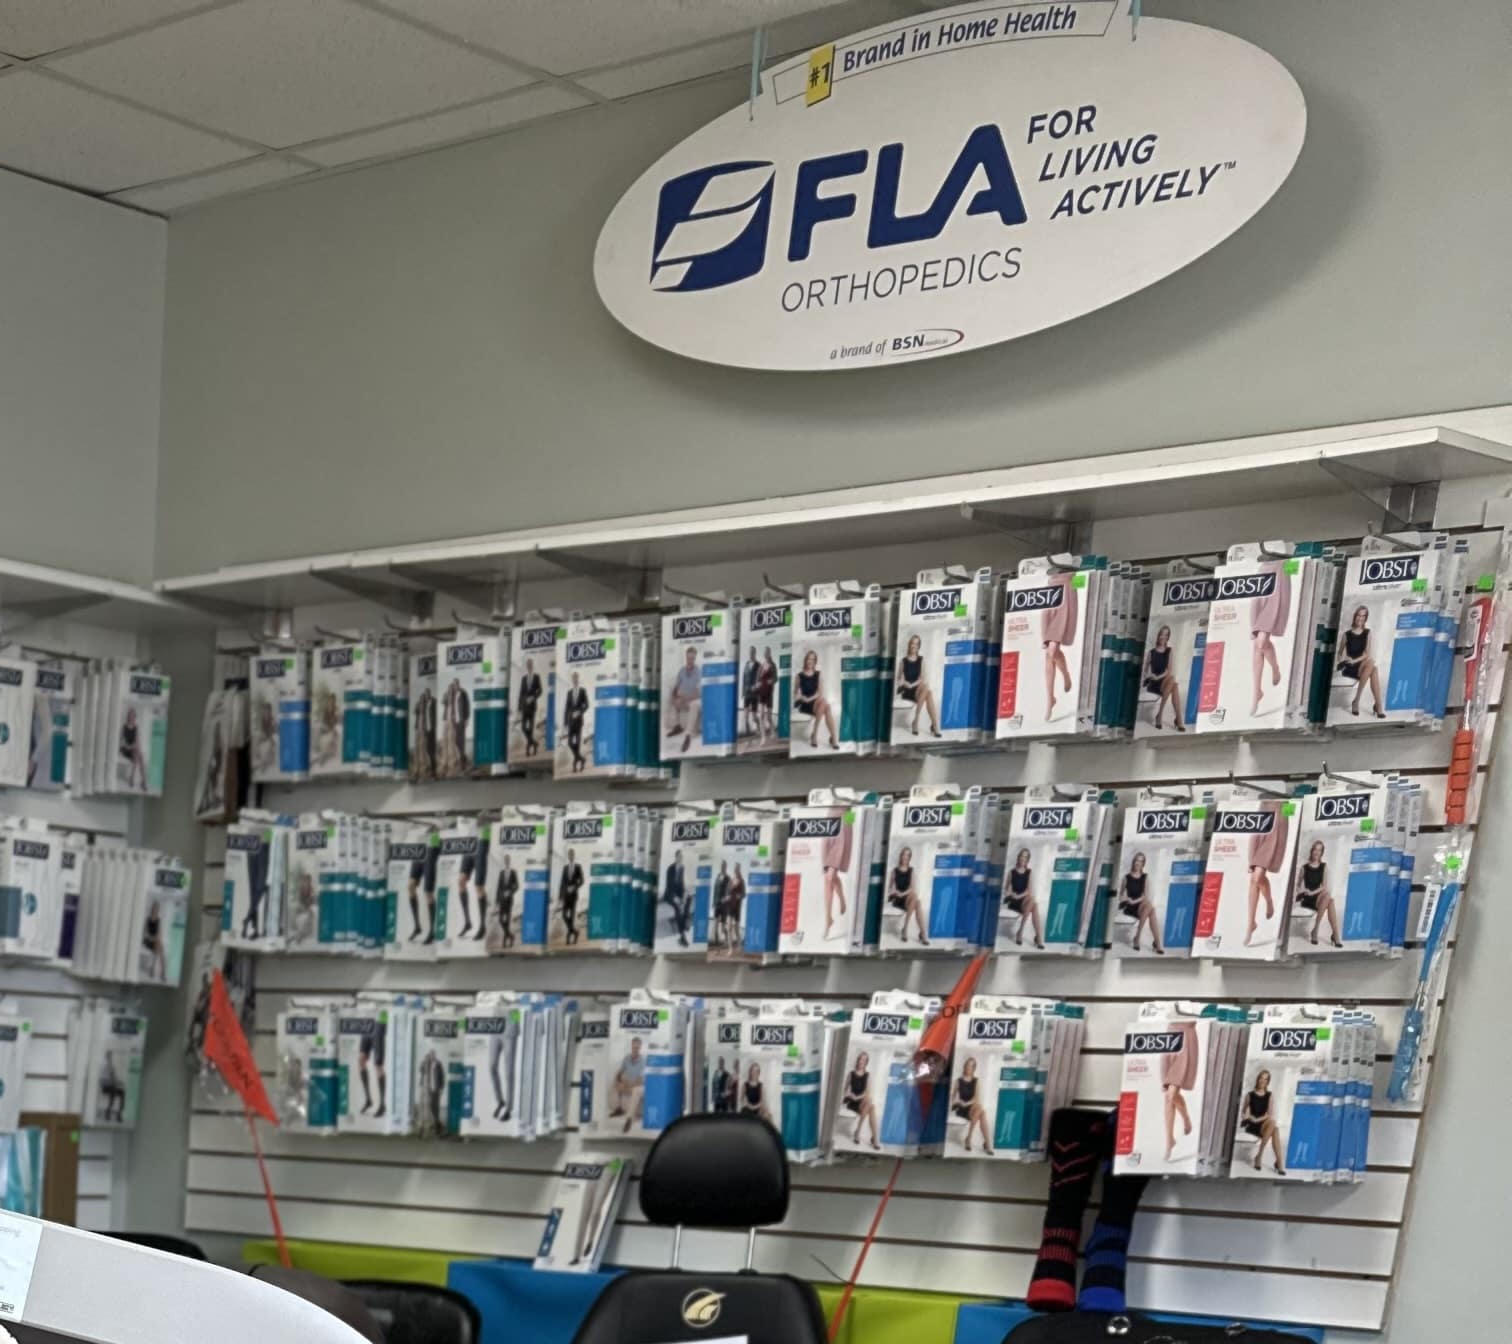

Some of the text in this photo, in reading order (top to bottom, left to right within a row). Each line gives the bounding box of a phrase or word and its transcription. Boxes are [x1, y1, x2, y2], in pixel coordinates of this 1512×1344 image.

[843, 29, 906, 73] Brand
[911, 28, 930, 53] in
[938, 17, 999, 46] Home
[1004, 5, 1077, 35] Health
[1027, 105, 1097, 145] FOR
[1039, 133, 1158, 183] LIVING
[787, 122, 1028, 263] FLA
[780, 246, 1023, 313] ORTHOPEDICS
[830, 334, 925, 360] a brand of BSN
[1361, 557, 1412, 585] JOBST
[1167, 583, 1210, 606] JOBST
[1217, 576, 1263, 599] JOBST
[913, 590, 958, 615] JOBST
[1010, 589, 1050, 611] JOBST
[674, 615, 709, 639] JOBST
[752, 605, 787, 630] JOBST
[806, 607, 848, 631] JOBST
[522, 626, 557, 649] JOBST
[321, 648, 353, 669] JOBST
[447, 643, 481, 665] JOBST
[566, 640, 603, 664] JOBST
[906, 805, 945, 827] JOBST
[1025, 808, 1067, 828] JOBST
[1317, 797, 1361, 819] JOBST
[564, 819, 598, 839] JOBST
[672, 822, 707, 840] JOBST
[791, 818, 832, 836] JOBST
[1139, 810, 1184, 831] JOBST
[1217, 813, 1261, 831] JOBST
[500, 826, 534, 845] JOBST
[724, 827, 759, 845] JOBST
[621, 1010, 656, 1029] JOBST
[864, 1014, 903, 1034] JOBST
[970, 1019, 1012, 1039] JOBST
[752, 1026, 788, 1045] JOBST
[1127, 1033, 1172, 1052] JOBST
[1265, 1029, 1310, 1049] JOBST
